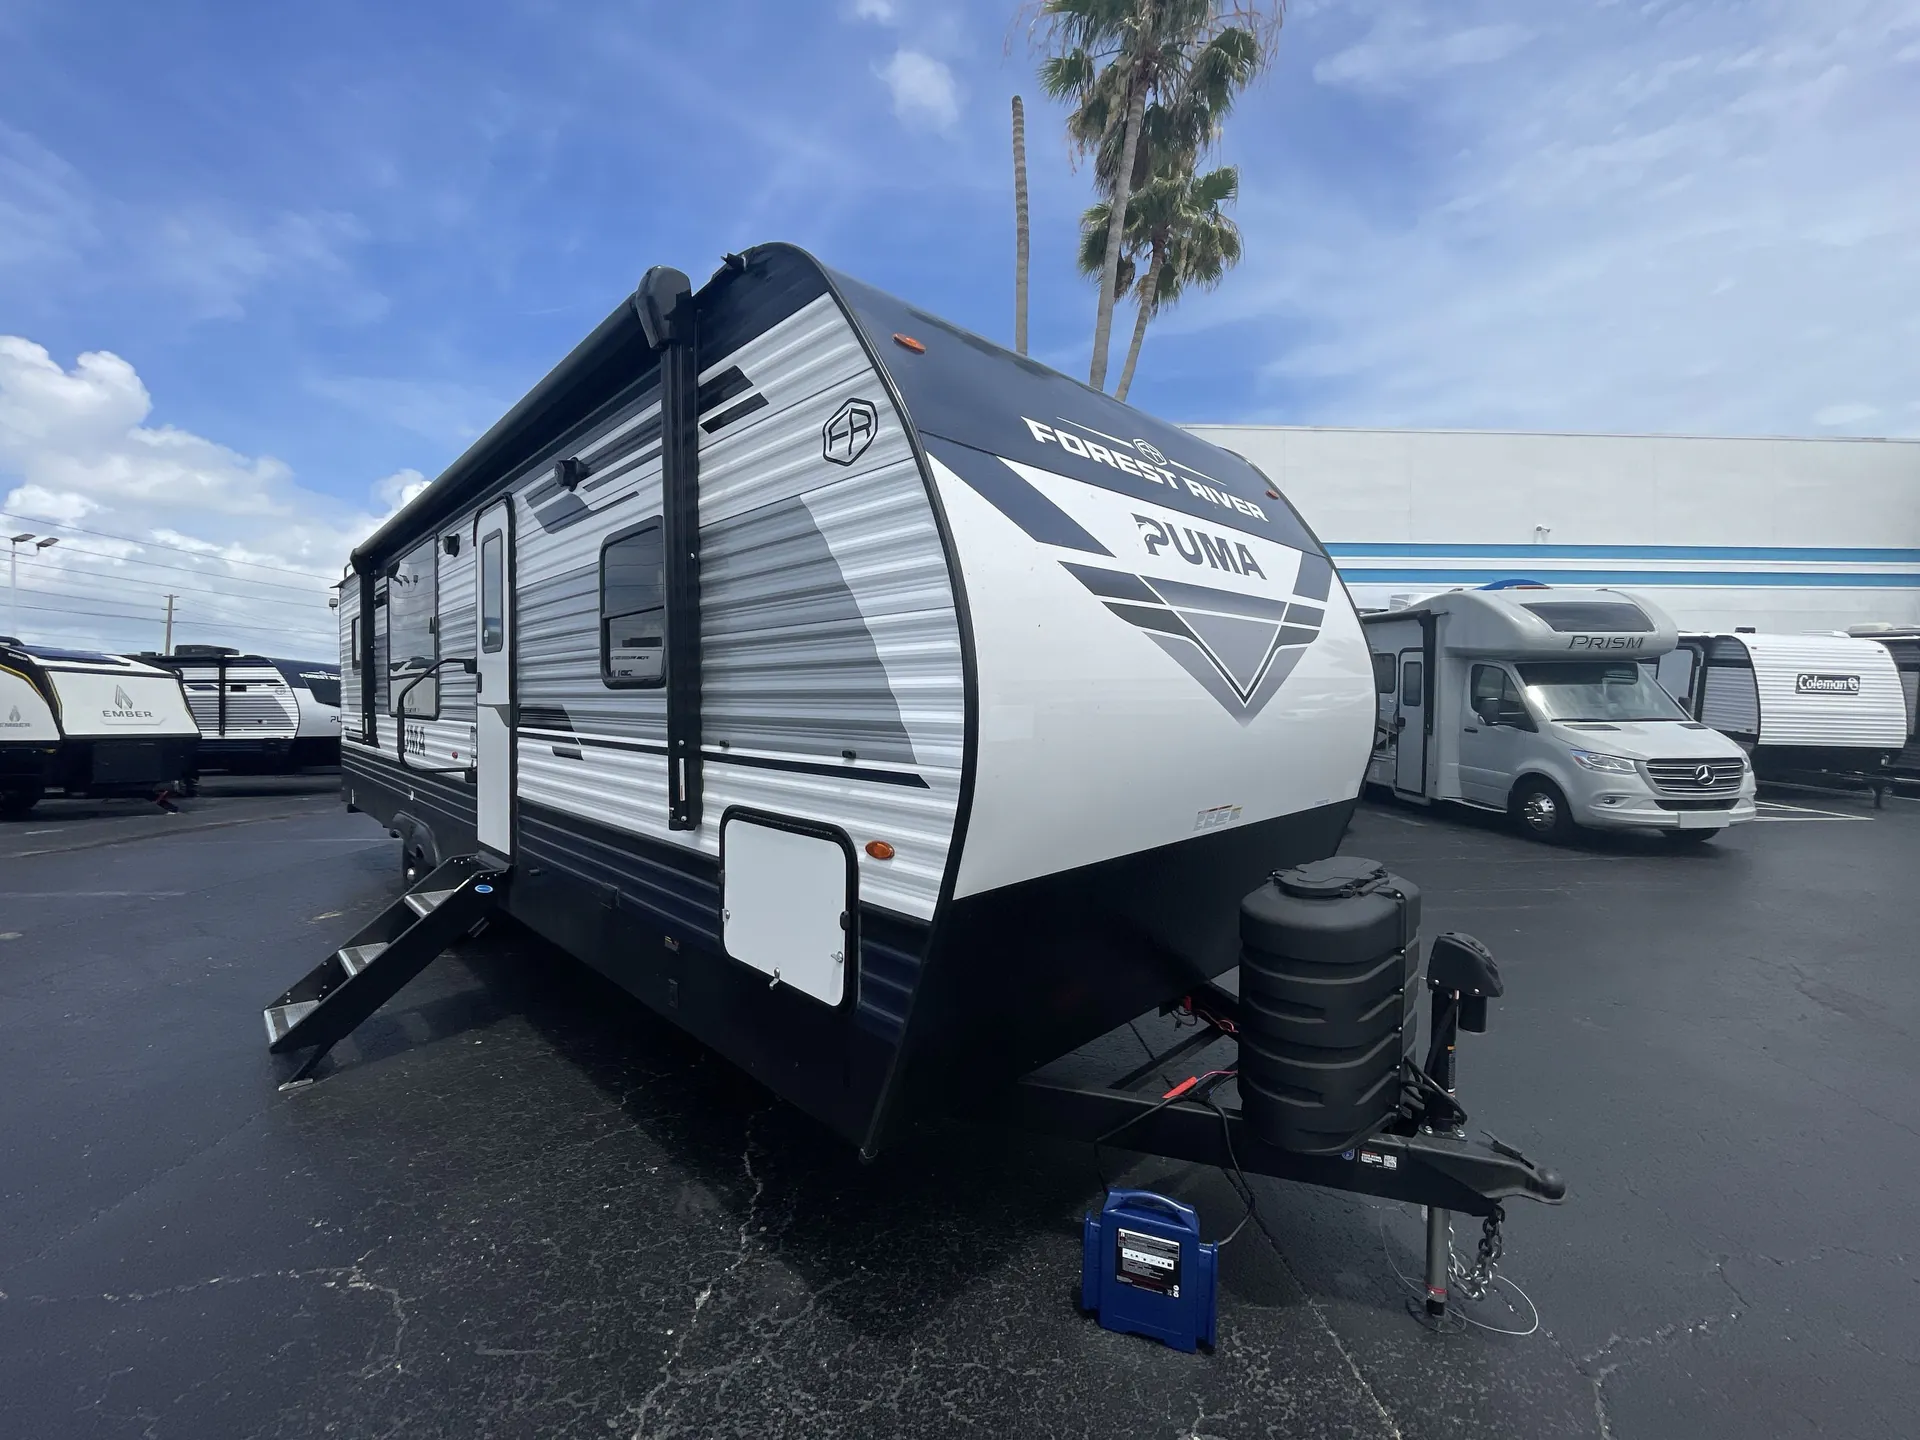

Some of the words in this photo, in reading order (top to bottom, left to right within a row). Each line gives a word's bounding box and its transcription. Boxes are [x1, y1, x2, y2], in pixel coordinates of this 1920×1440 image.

[1020, 415, 1179, 490] FOREST
[1180, 475, 1270, 523] RIVER
[1130, 512, 1268, 581] PUMA
[1798, 675, 1847, 690] Coleman
